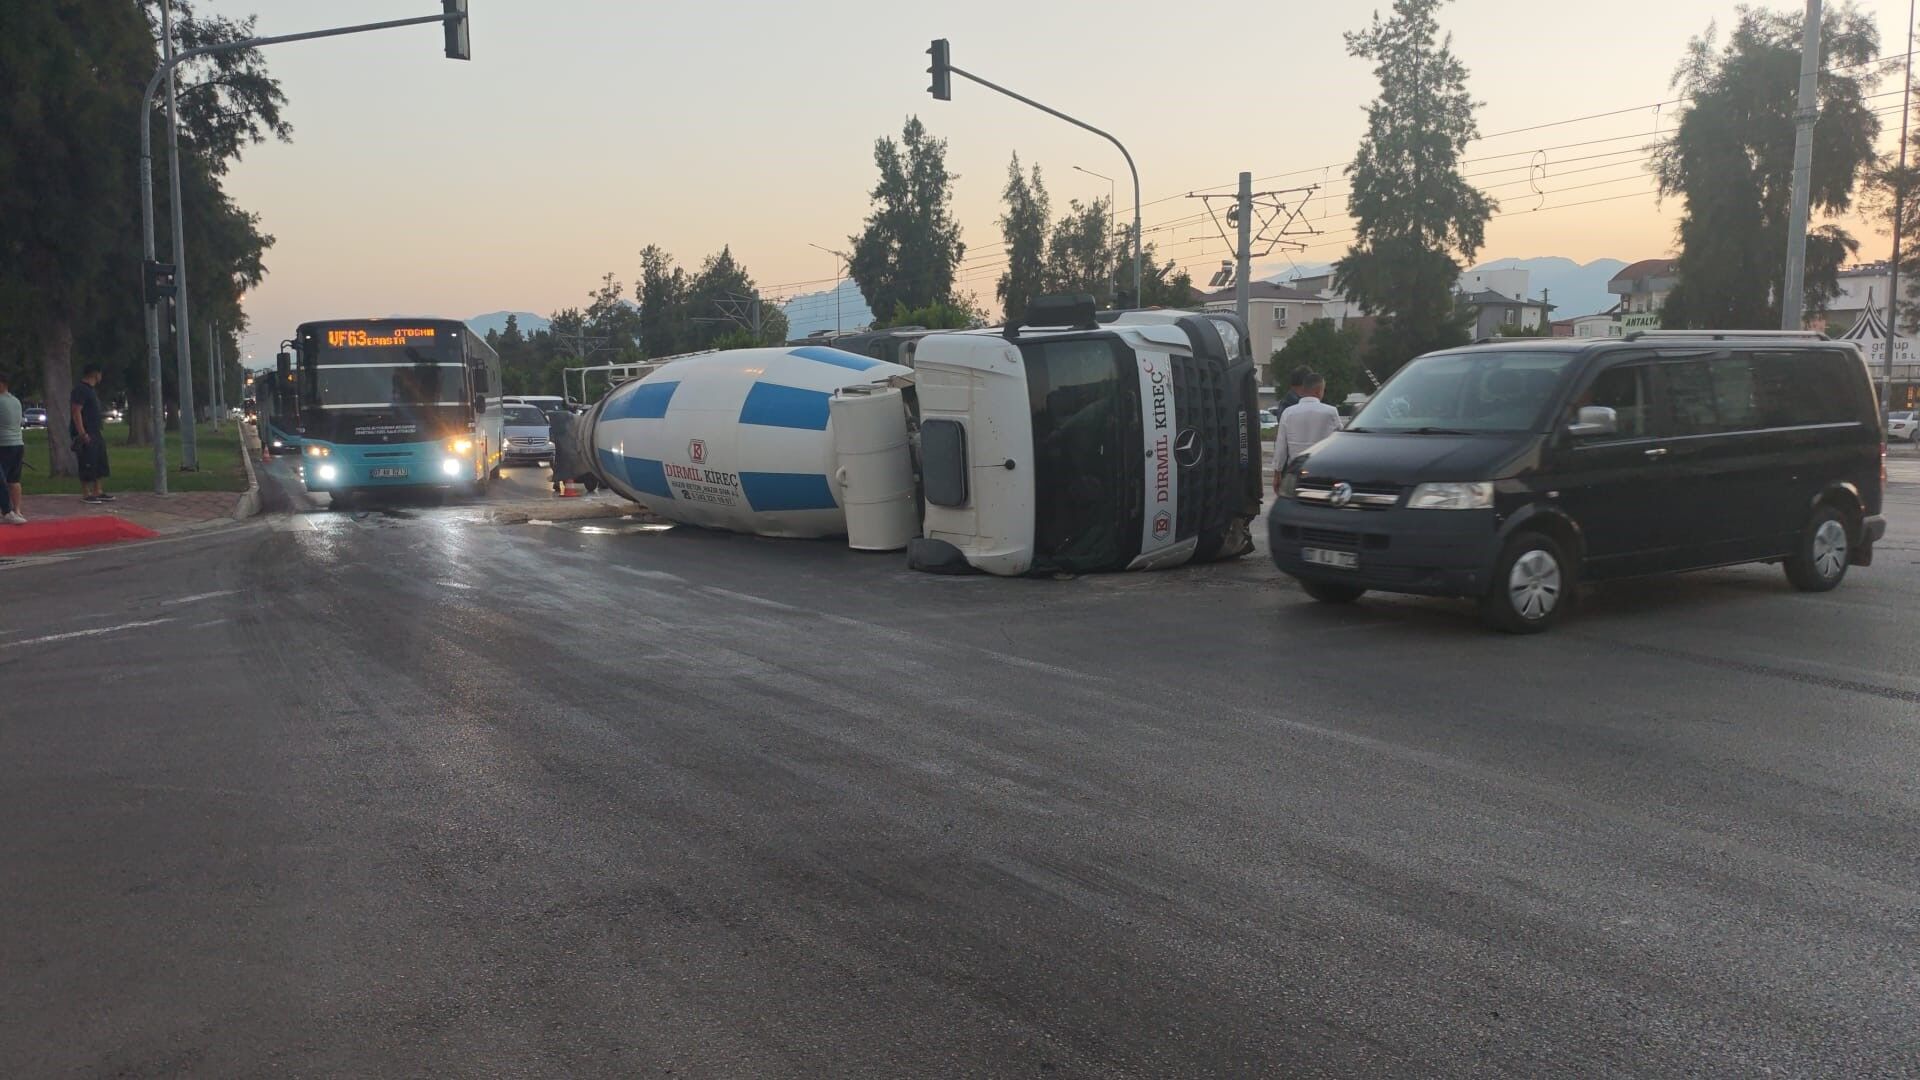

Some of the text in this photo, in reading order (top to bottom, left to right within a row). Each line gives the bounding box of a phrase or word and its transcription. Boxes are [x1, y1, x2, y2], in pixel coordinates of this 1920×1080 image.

[1626, 317, 1658, 327] ANTALYA
[1871, 342, 1909, 352] grup
[1152, 371, 1169, 504] DİRMİL KİREÇ
[665, 464, 739, 490] DİRMİL KİREÇ
